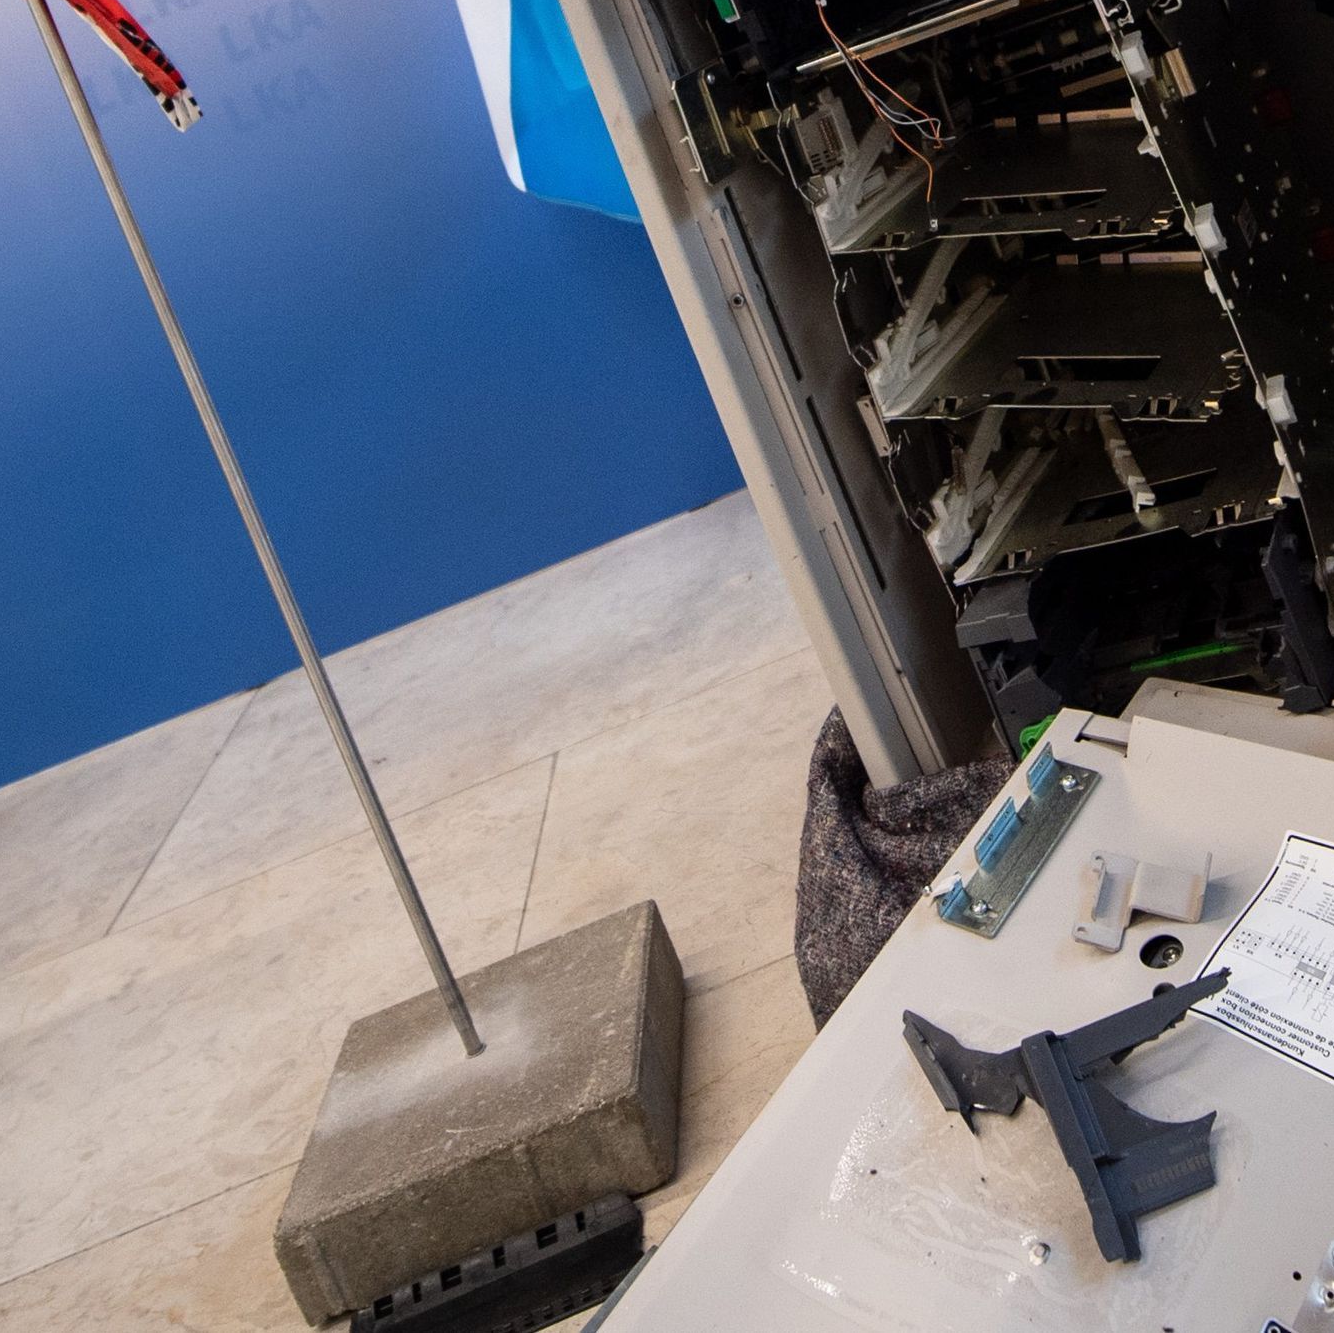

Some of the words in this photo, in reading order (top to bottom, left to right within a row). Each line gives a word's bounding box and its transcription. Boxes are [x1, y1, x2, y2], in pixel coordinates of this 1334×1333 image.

[1219, 996, 1238, 1012] box
[1224, 987, 1249, 1005] client
[1213, 1005, 1306, 1057] Kundenanschlussbox
[1236, 1004, 1287, 1035] connection
[1268, 1009, 1314, 1037] connexion
[1287, 1029, 1331, 1058] Customer
[1313, 1032, 1327, 1044] de
